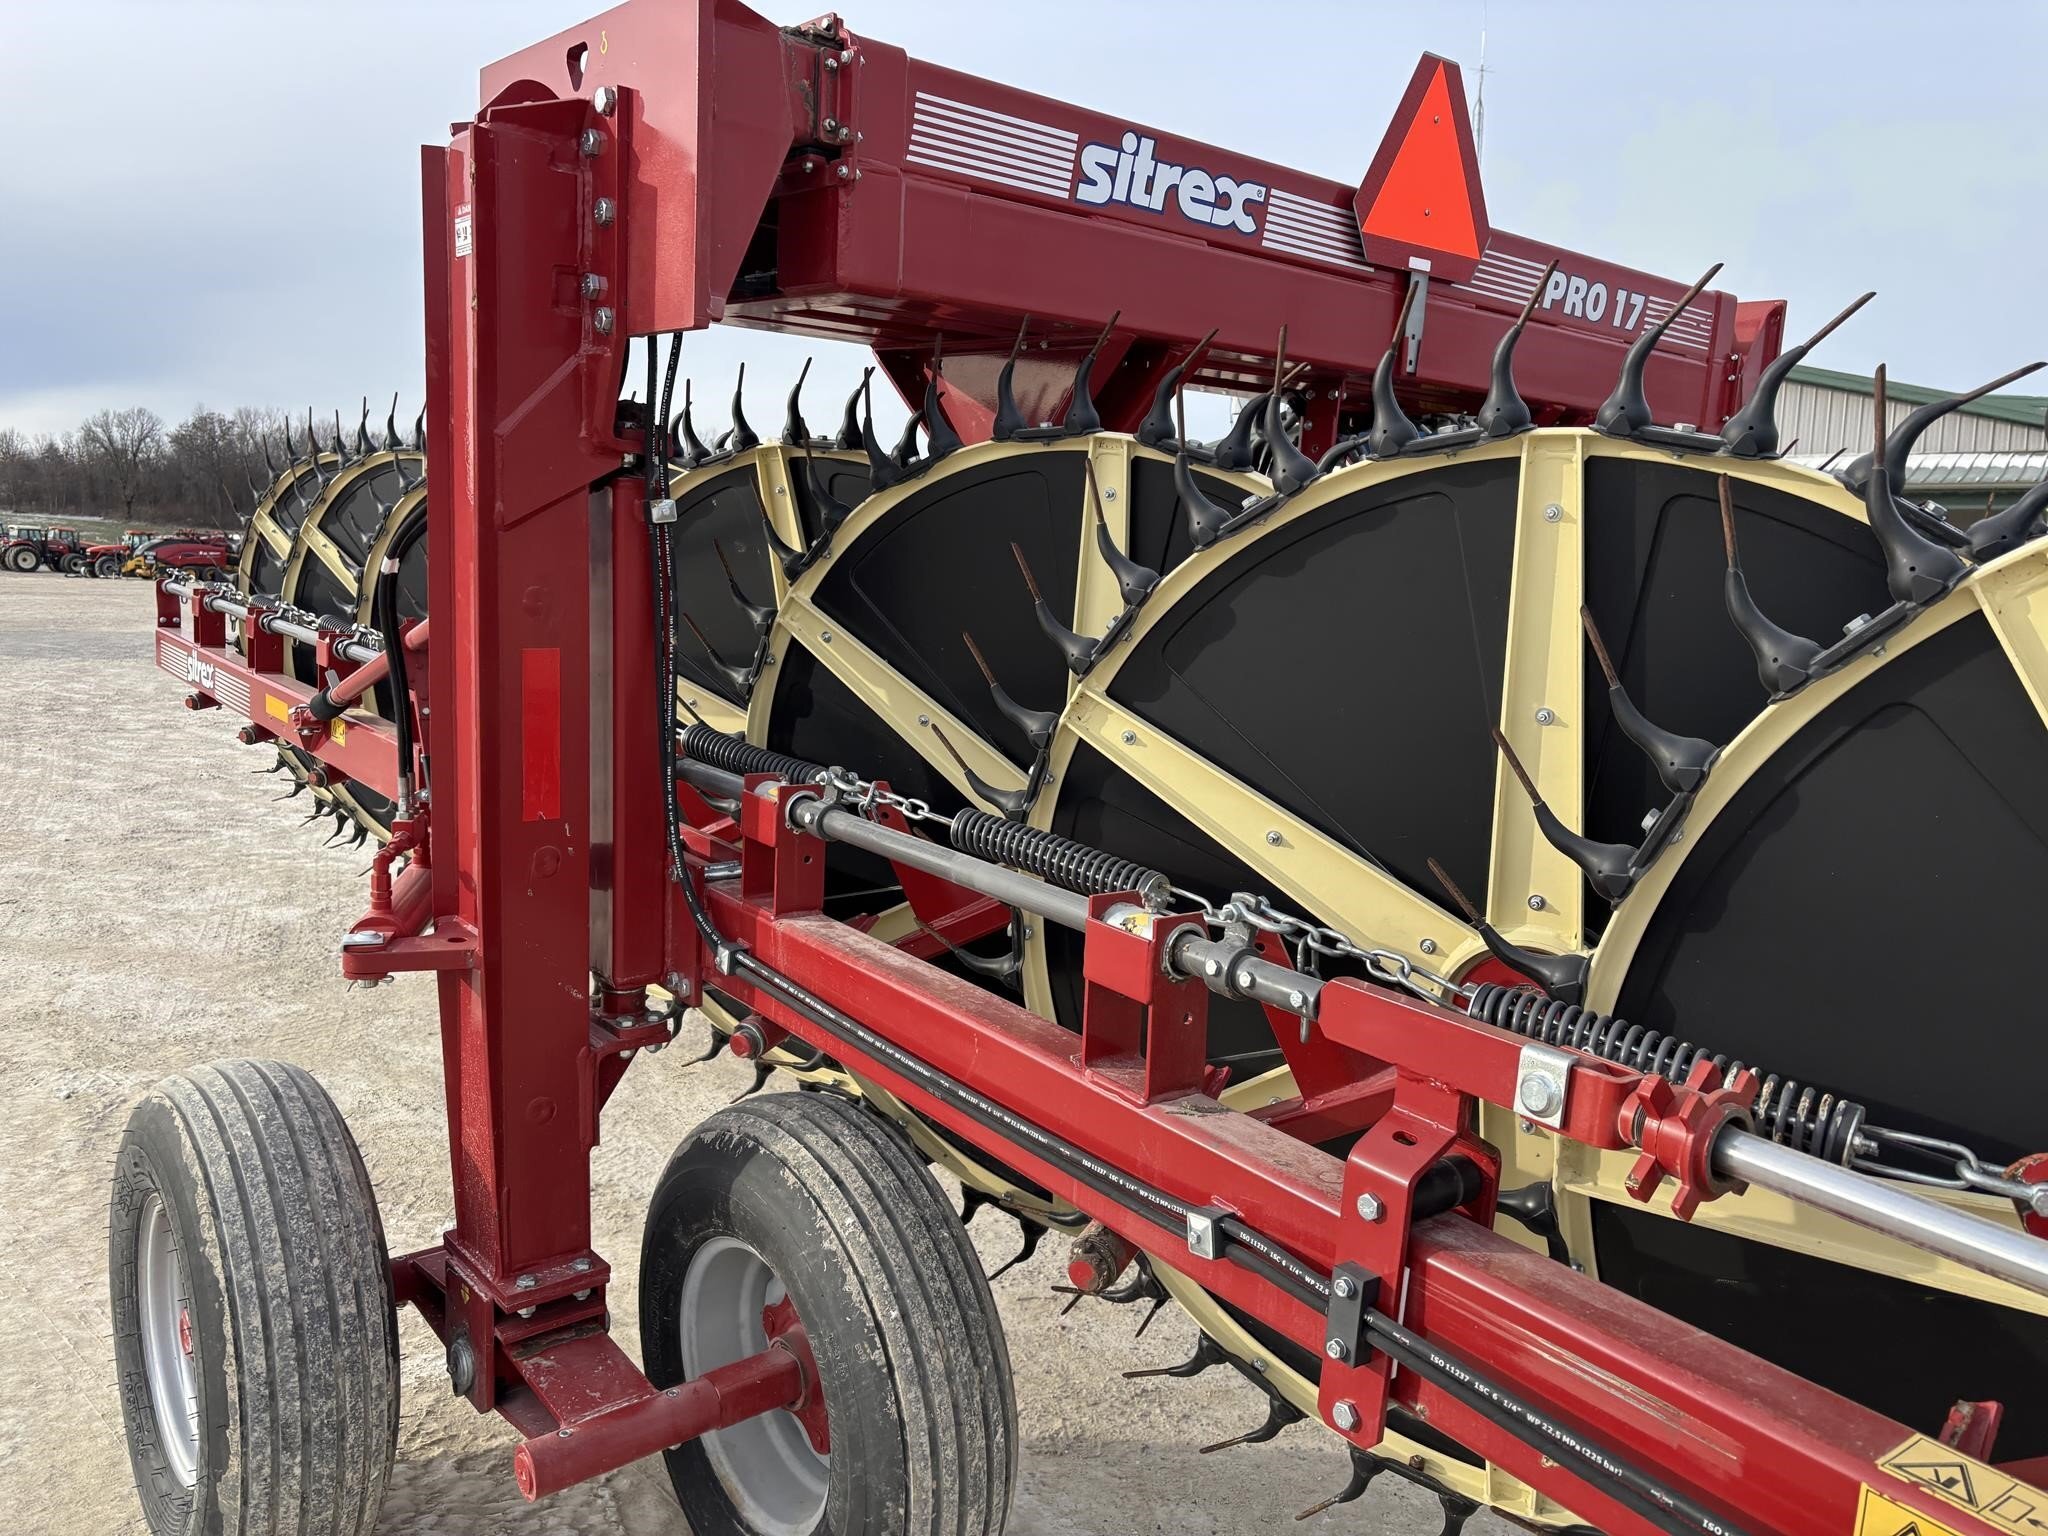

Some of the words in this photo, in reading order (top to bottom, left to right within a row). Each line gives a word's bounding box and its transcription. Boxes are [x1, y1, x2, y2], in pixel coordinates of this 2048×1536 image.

[1076, 131, 1267, 233] sitrex
[1542, 270, 1608, 322] PRO
[1612, 289, 1646, 331] 17
[1240, 1231, 1250, 1242] ISO
[1250, 1238, 1268, 1253] 11237
[1304, 1275, 1315, 1286] WP
[1430, 1353, 1444, 1367] ISO
[1445, 1363, 1469, 1382] 11237
[1474, 1381, 1490, 1396] 1SC
[1492, 1393, 1498, 1401] 6
[1526, 1413, 1541, 1425] WP
[1542, 1422, 1561, 1439] 22,5
[1562, 1434, 1581, 1452] MPa
[1581, 1446, 1602, 1464] (225
[1603, 1460, 1623, 1477] bar)
[1702, 1519, 1722, 1535] ISO
